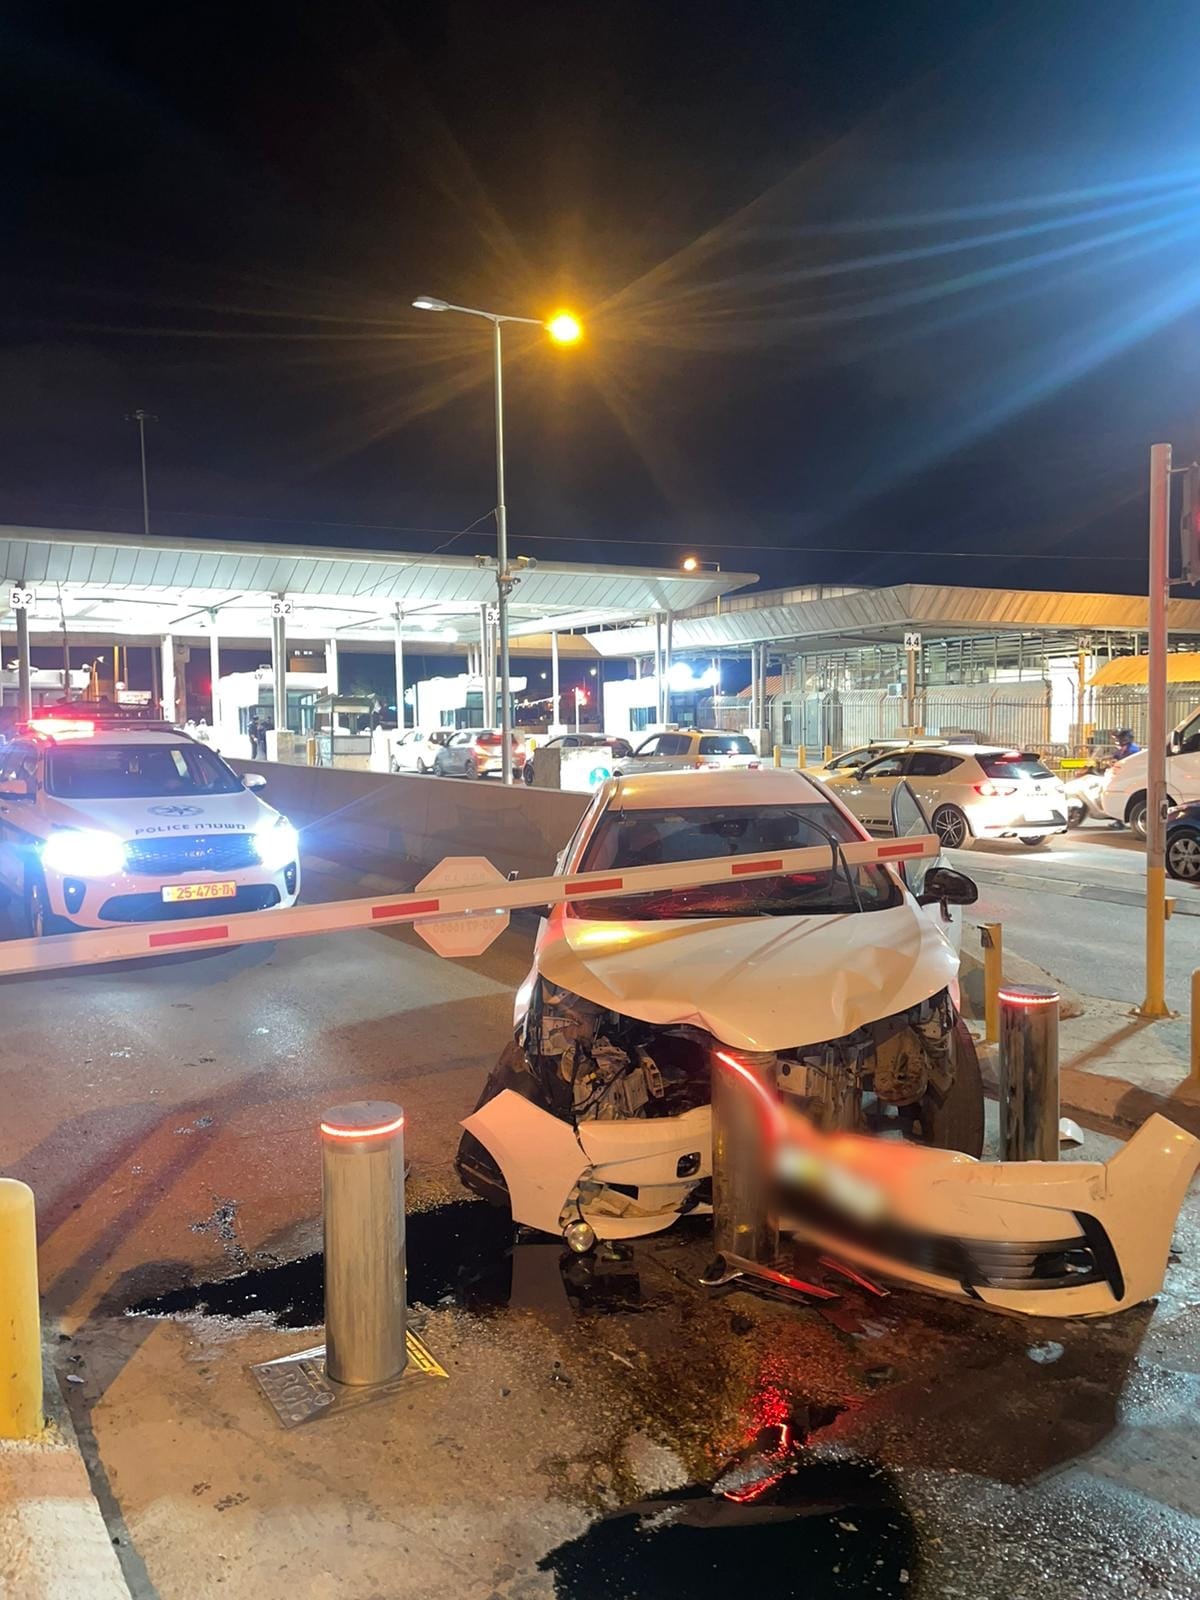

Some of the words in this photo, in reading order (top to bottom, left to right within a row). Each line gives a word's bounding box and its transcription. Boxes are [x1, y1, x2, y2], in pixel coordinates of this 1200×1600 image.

[12, 592, 33, 604] 5.2
[273, 603, 292, 614] 5.2
[135, 823, 191, 835] POLICE
[194, 822, 247, 831] משטרה
